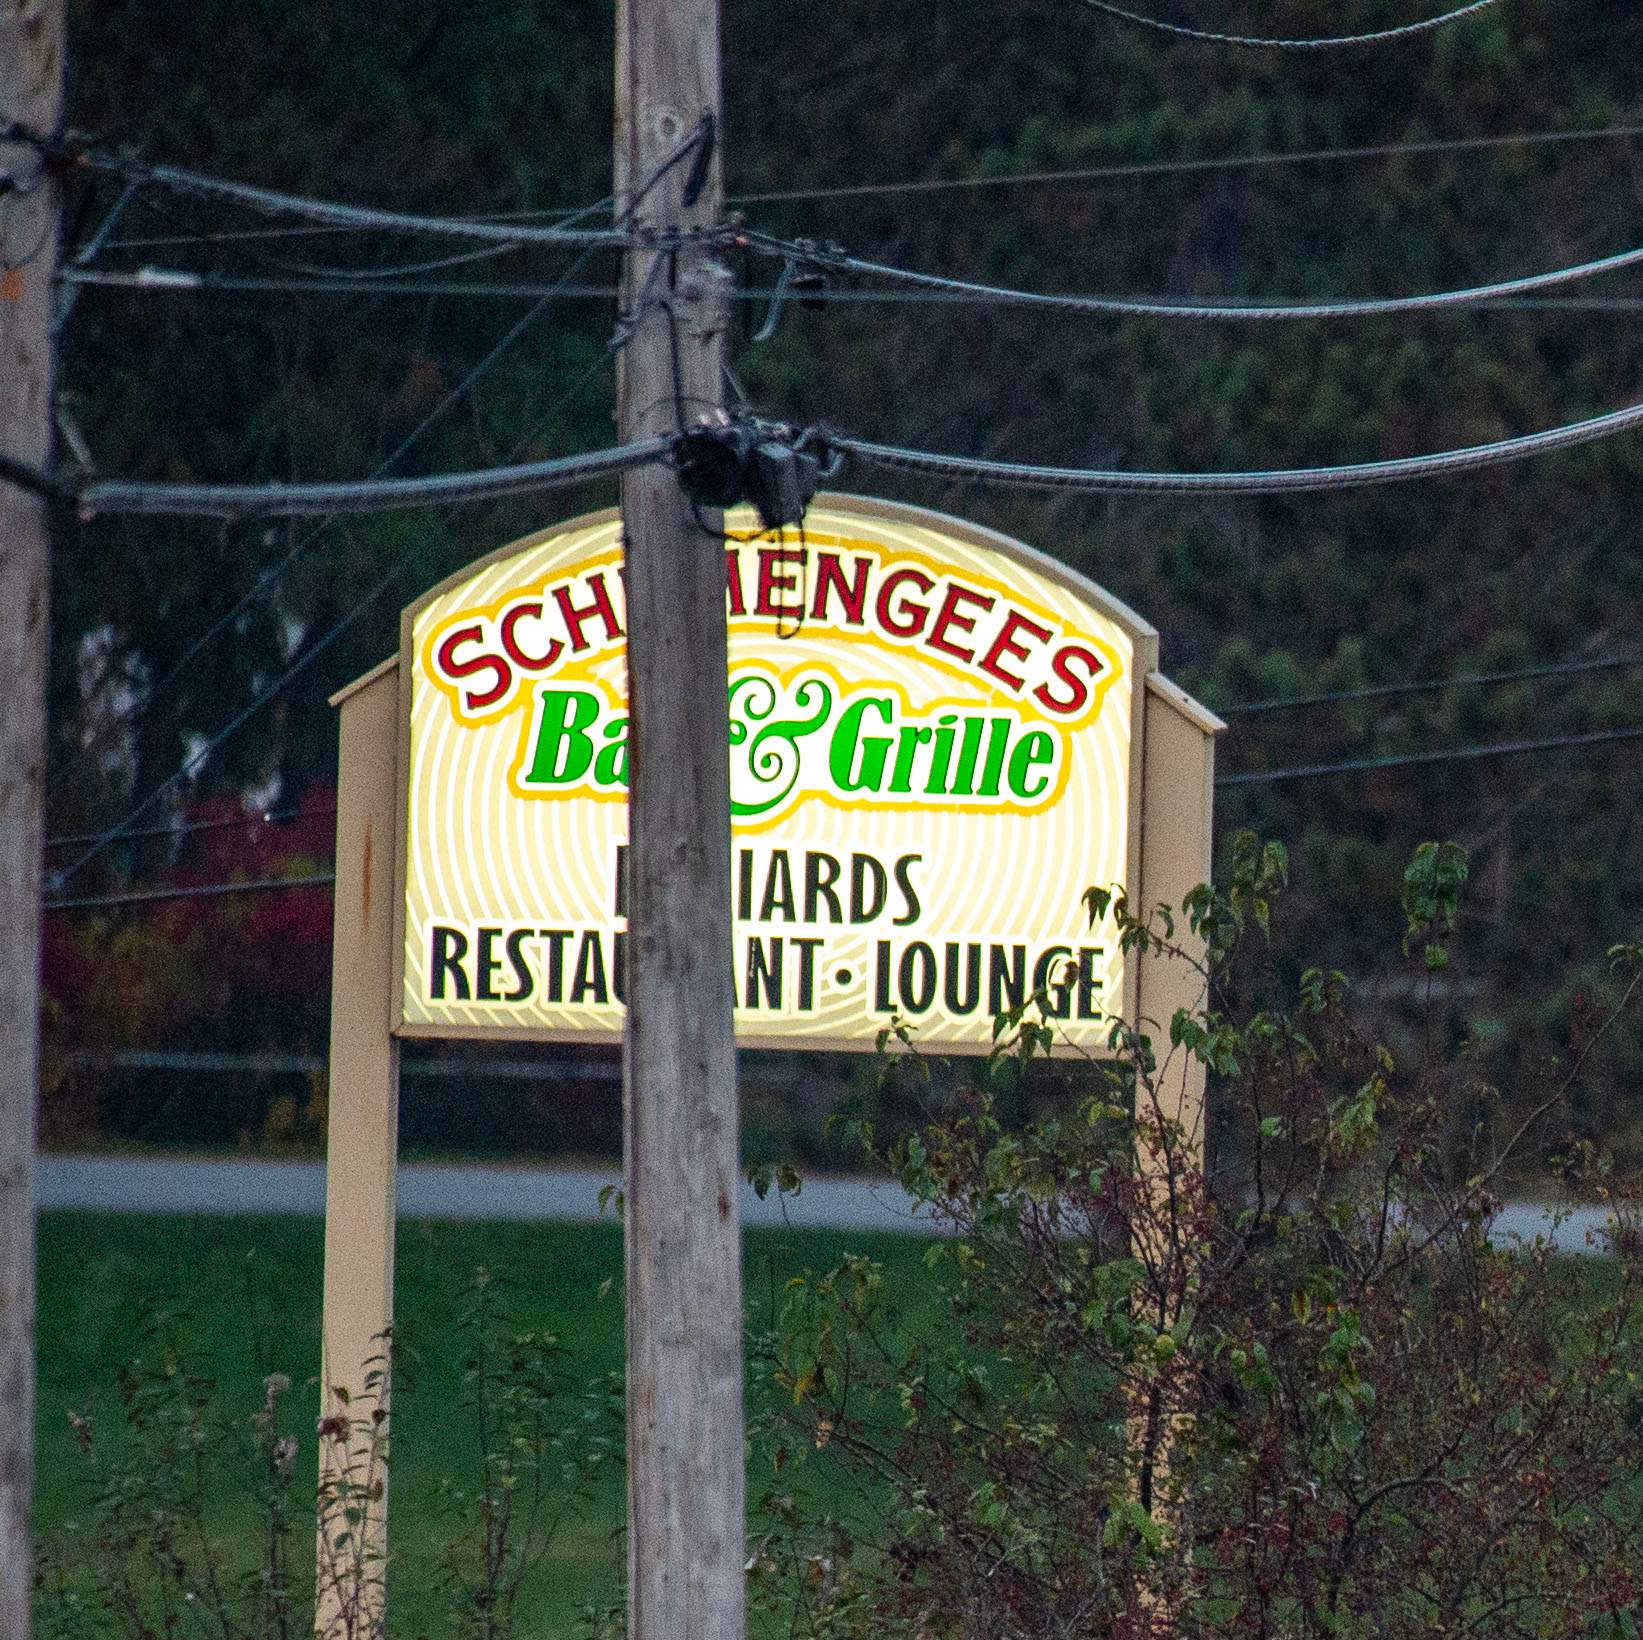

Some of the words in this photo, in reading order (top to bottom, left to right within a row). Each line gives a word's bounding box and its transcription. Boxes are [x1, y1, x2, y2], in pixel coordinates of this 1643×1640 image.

[438, 548, 1105, 713] SCHENGEES
[525, 690, 629, 787] Ba
[829, 697, 1054, 799] Grille
[615, 846, 922, 927] IARDS
[430, 926, 824, 1011] RESTANT
[875, 940, 1104, 1020] LOUNGE
